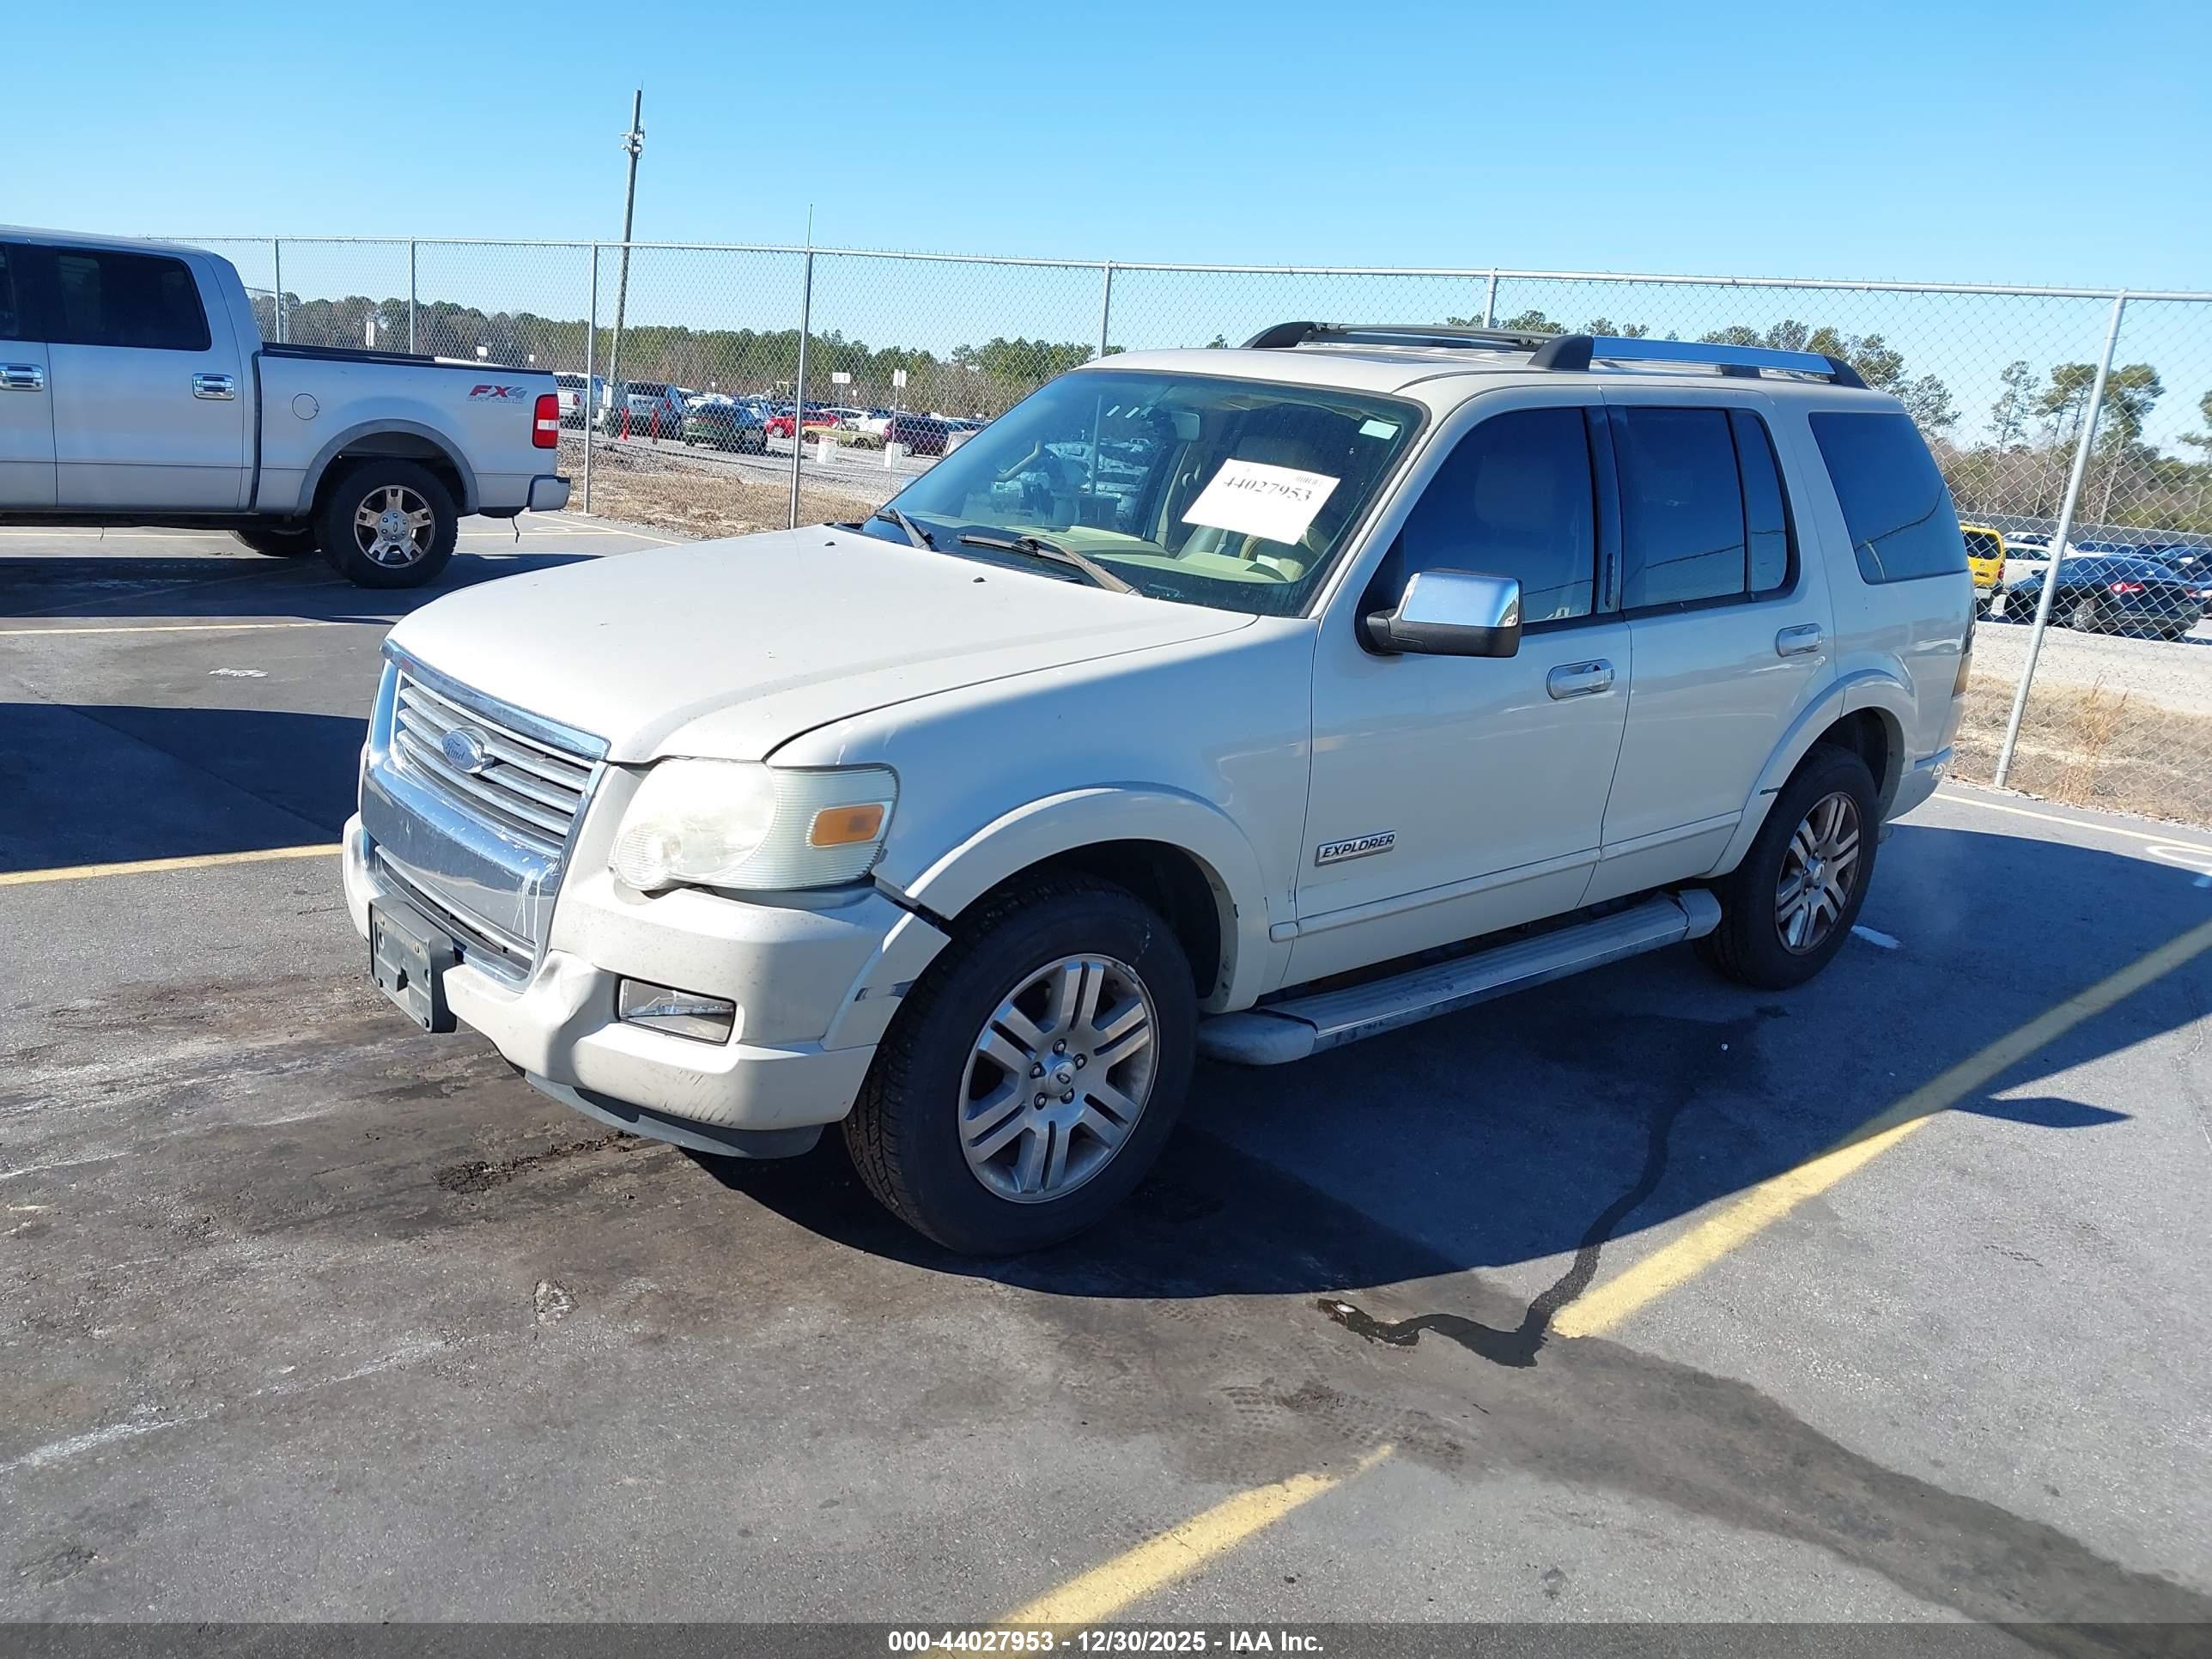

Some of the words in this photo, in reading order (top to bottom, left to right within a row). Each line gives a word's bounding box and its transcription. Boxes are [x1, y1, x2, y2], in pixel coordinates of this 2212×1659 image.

[470, 384, 528, 399] FX4
[1223, 476, 1313, 501] 44027953
[445, 738, 465, 762] Ford
[1321, 833, 1395, 859] EXPLORER
